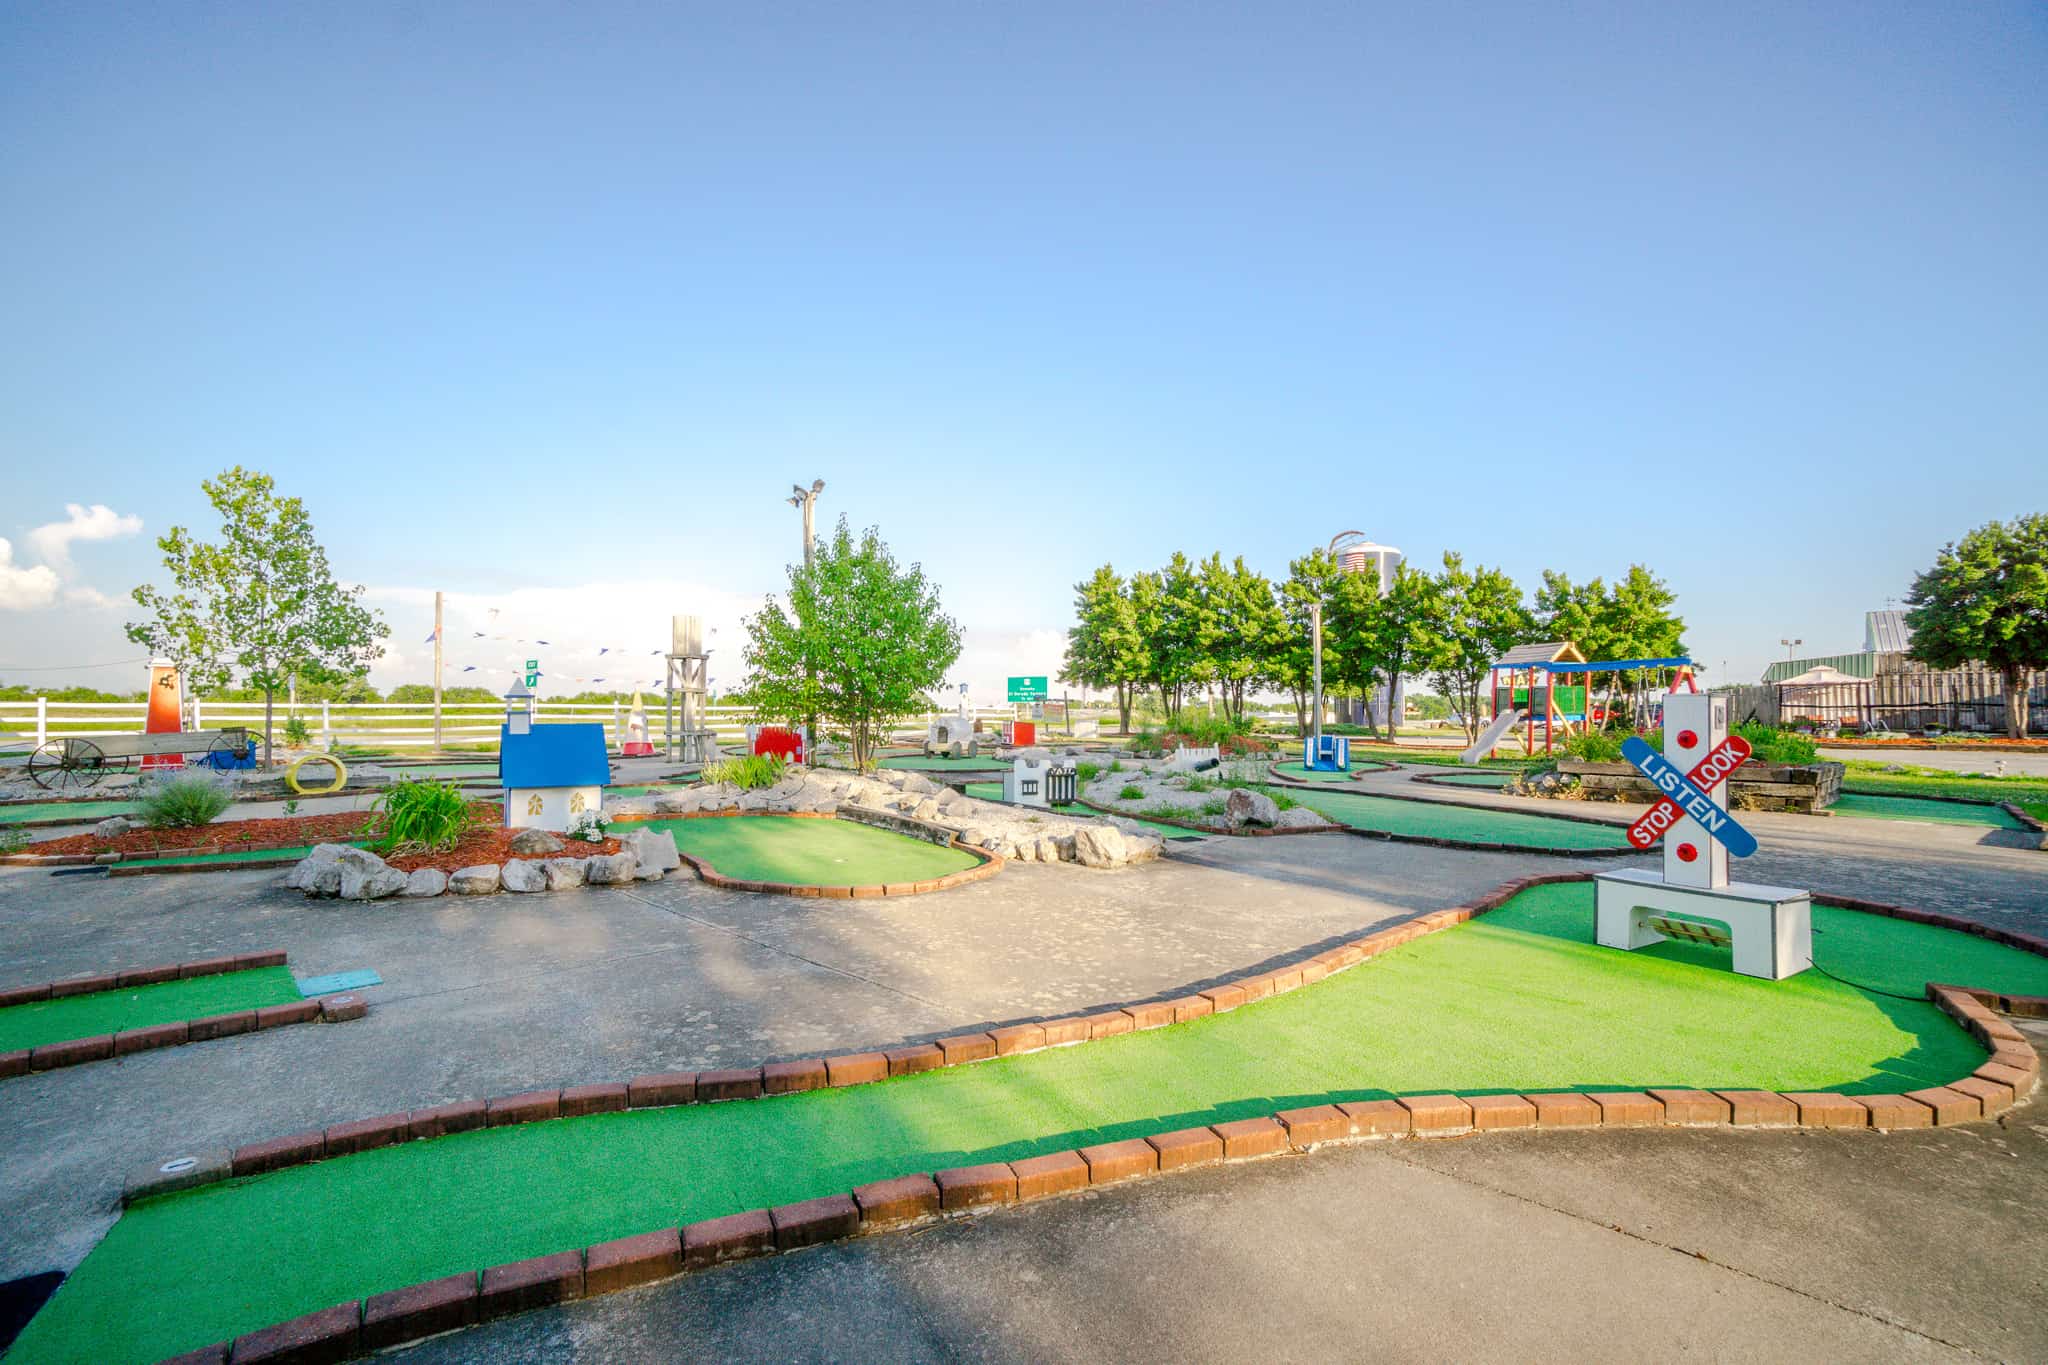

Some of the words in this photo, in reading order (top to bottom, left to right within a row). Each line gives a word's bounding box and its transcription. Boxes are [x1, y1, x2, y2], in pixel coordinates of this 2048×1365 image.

[1691, 742, 1744, 790] LOOK
[1639, 755, 1727, 832] LISTEN
[1633, 802, 1676, 844] STOP
